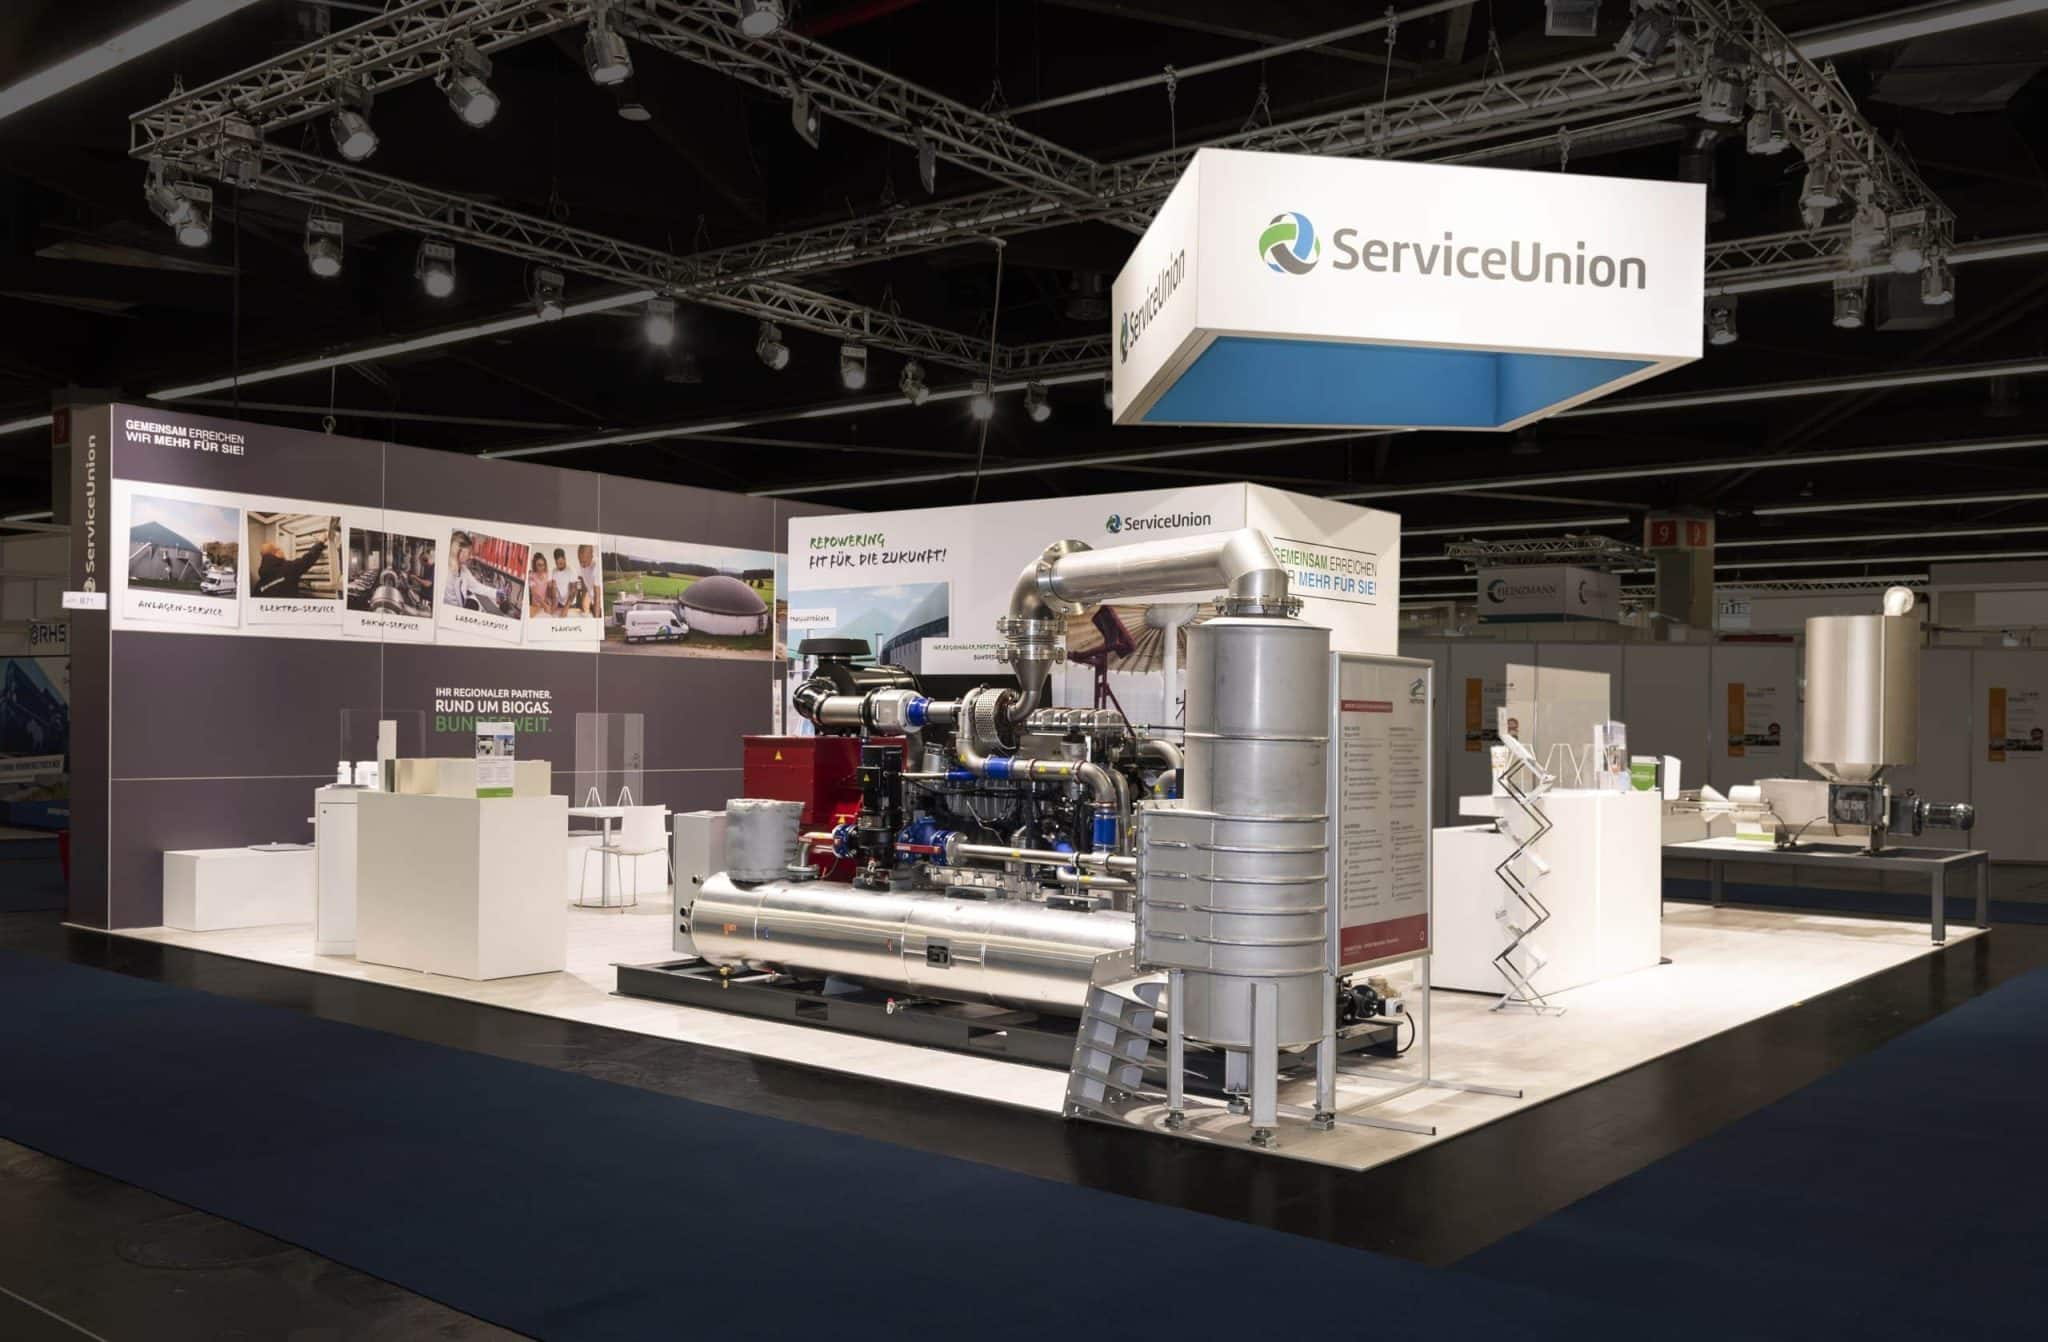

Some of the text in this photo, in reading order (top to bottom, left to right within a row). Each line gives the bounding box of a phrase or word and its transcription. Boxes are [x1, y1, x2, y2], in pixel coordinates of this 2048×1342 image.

[1332, 228, 1646, 290] ServiceUnion
[1130, 249, 1185, 348] ServiceUnion
[125, 419, 245, 445] GEMEINSAM ERREICHEN
[125, 430, 245, 456] WIR MEHR FÜR SIE!
[85, 434, 97, 574] ServiceUnion
[1124, 511, 1212, 531] ServiceUnion
[809, 533, 885, 549] REPOWERING
[1660, 525, 1670, 543] 9
[809, 548, 947, 569] FIT FÜR DIE ZUKUNFT!
[1274, 547, 1328, 570] GEMEINSAM
[1299, 571, 1331, 590] MEHR
[1334, 574, 1356, 592] FÜR
[1358, 579, 1377, 596] SIE!
[138, 600, 224, 616] ANLAGEN-SERVICE
[435, 687, 553, 699] IHR REGIONALER PARTNER.
[435, 699, 553, 714] RUND UM BIOGAS.
